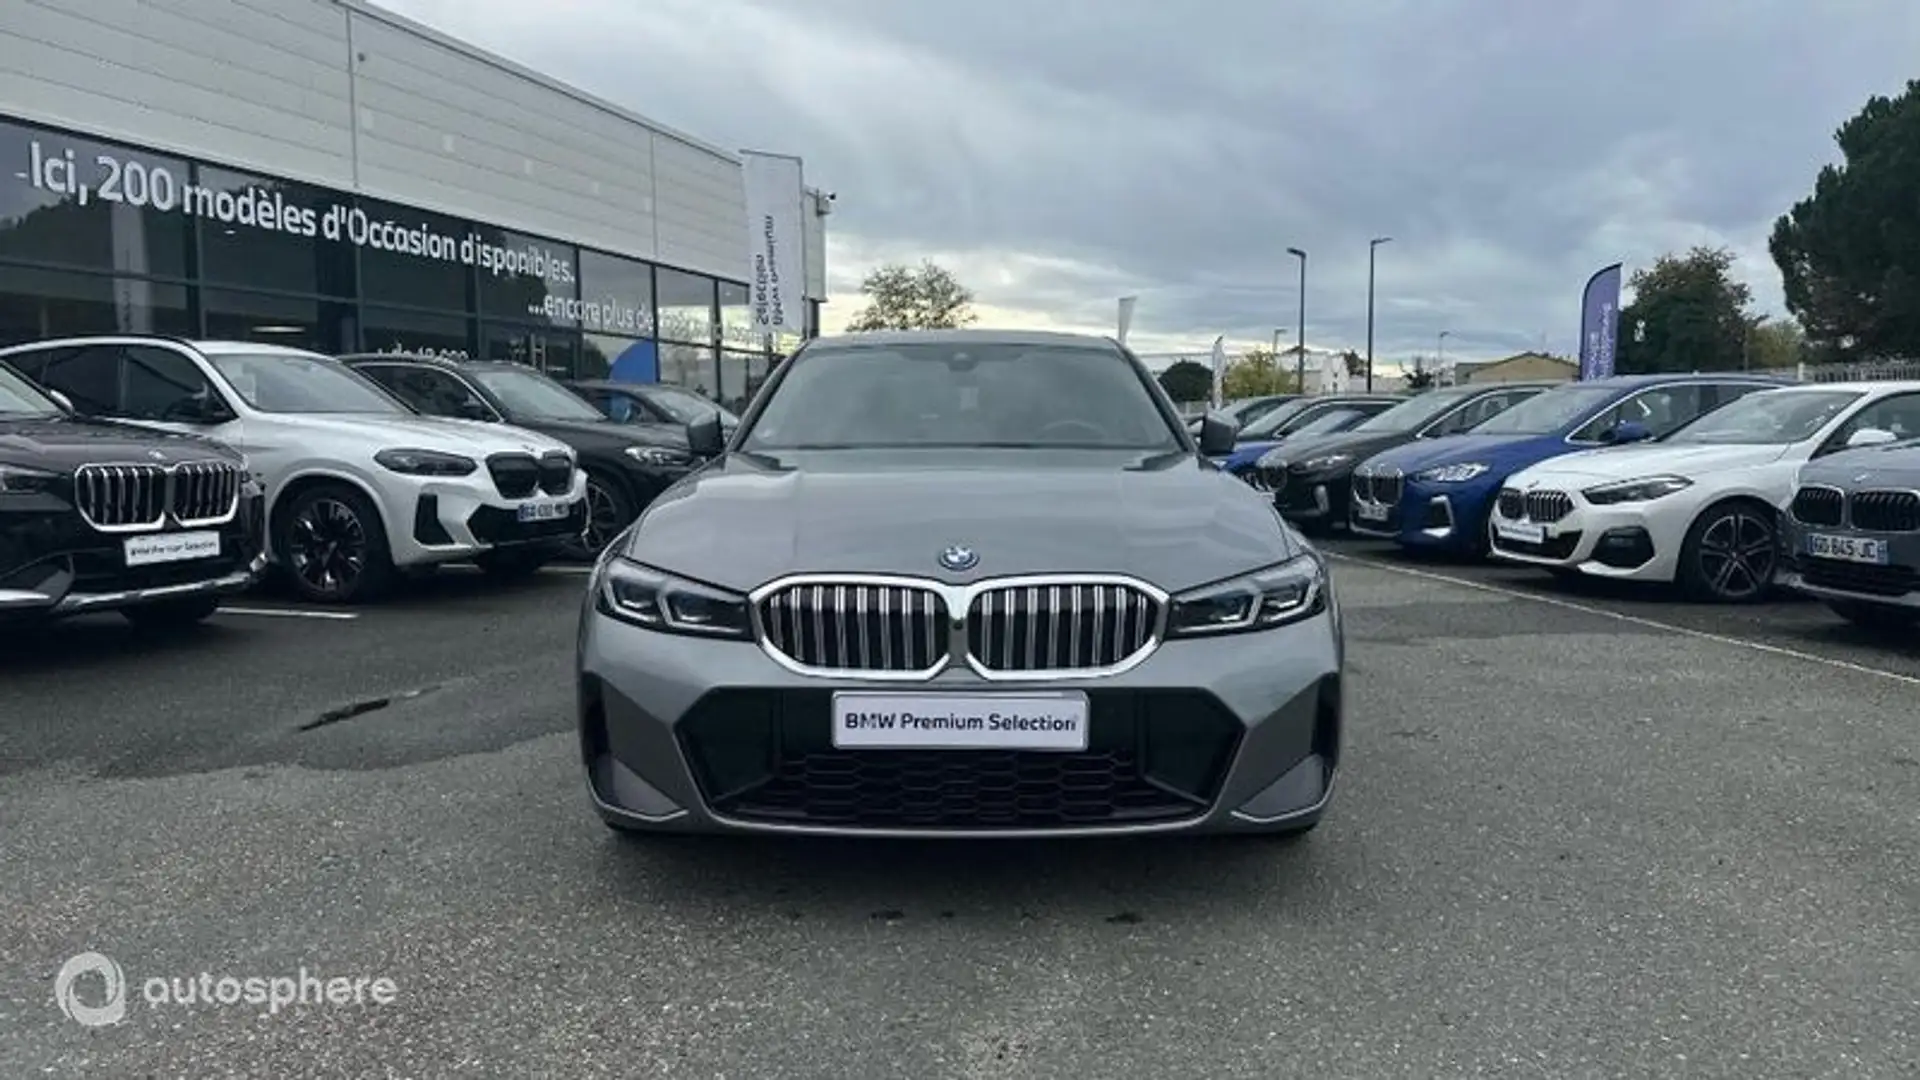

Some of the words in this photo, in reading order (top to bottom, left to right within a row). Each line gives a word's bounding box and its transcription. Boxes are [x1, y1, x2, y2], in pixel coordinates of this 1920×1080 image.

[28, 141, 88, 206] Ici,
[97, 155, 174, 212] 200
[182, 183, 316, 238] modèles
[322, 204, 456, 262] d'Occasion
[460, 232, 576, 283] disponibles.
[602, 297, 634, 330] plus
[845, 713, 896, 730] BMW
[900, 714, 983, 731] Premium
[988, 714, 1076, 731] Selection
